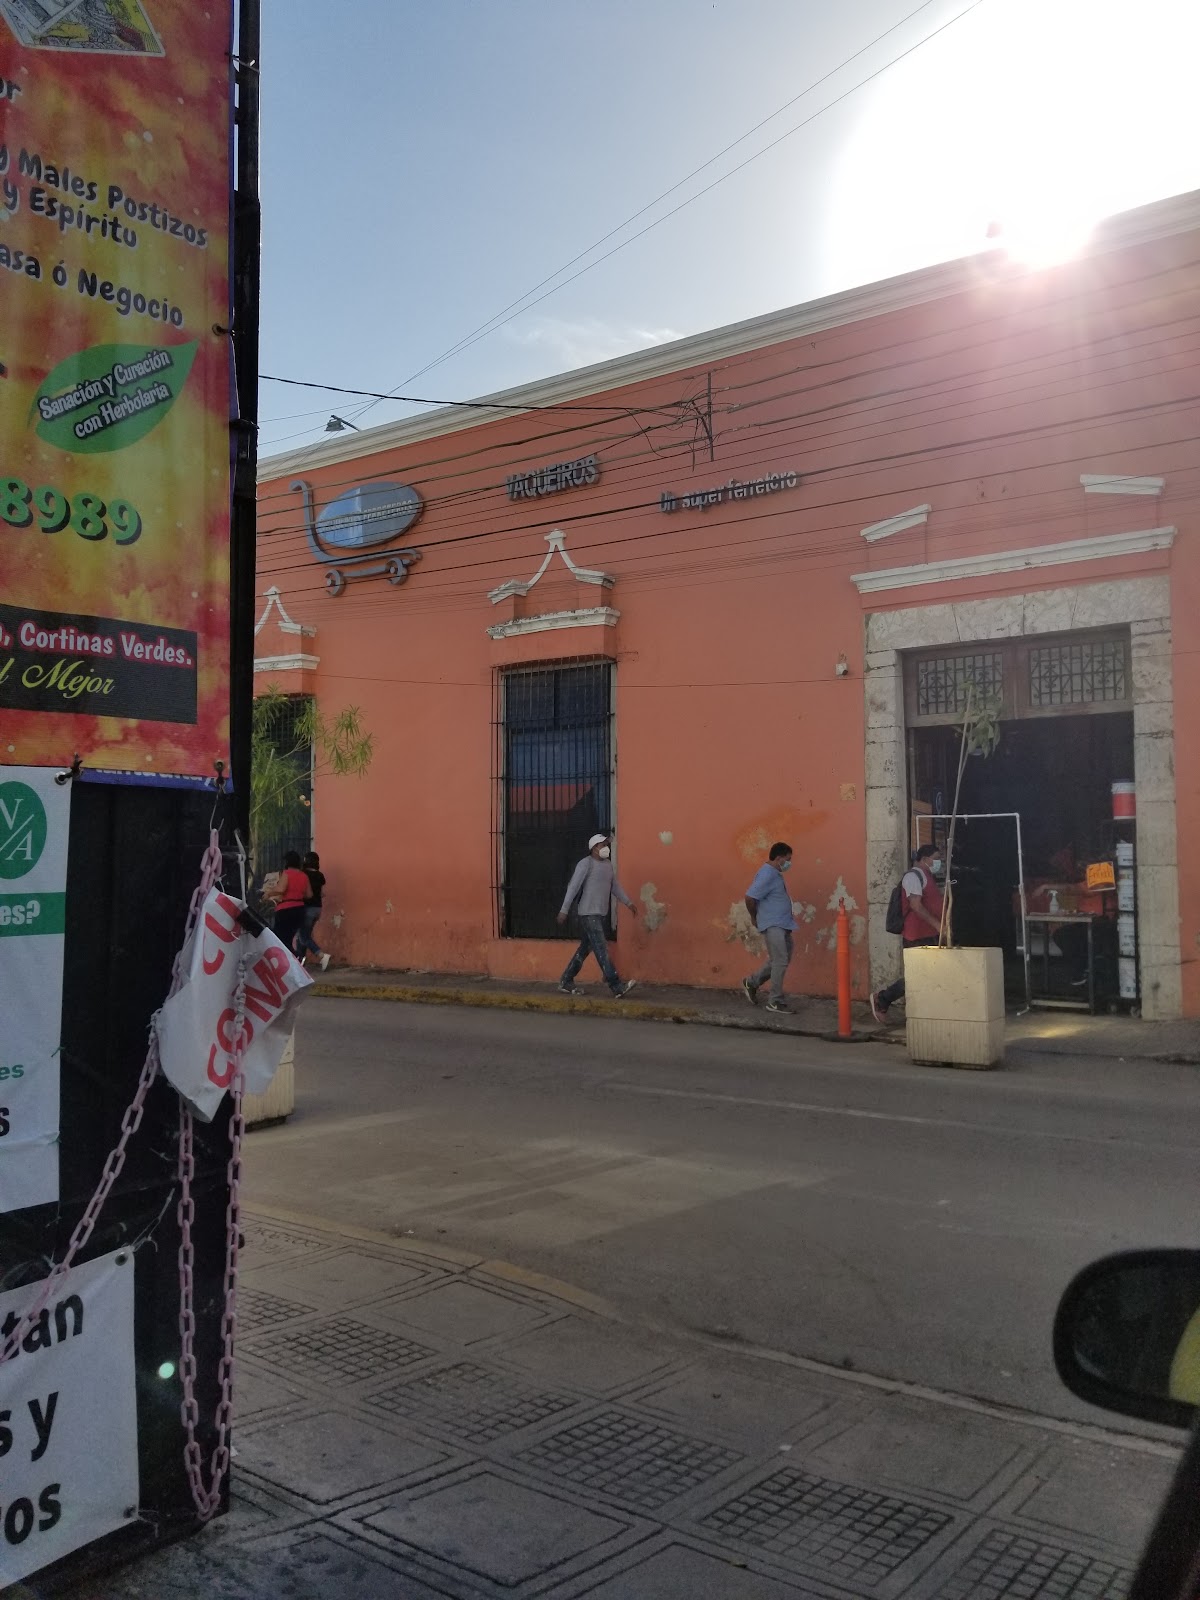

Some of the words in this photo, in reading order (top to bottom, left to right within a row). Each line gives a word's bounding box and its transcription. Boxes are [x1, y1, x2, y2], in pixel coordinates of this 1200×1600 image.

[4, 178, 18, 211] y
[30, 186, 137, 247] Espíritu
[19, 148, 97, 201] Males
[108, 185, 207, 246] Postizos
[53, 260, 67, 286] ó
[78, 269, 183, 326] Negocio
[39, 382, 102, 420] Sanación
[101, 374, 114, 396] y
[113, 350, 171, 385] Curación
[75, 415, 103, 439] con
[100, 383, 170, 425] Herbolaria
[20, 622, 113, 655] Cortinas
[121, 634, 192, 665] Verdes.
[21, 658, 116, 699] Mejor
[27, 1391, 59, 1462] y
[0, 1482, 62, 1545] os
